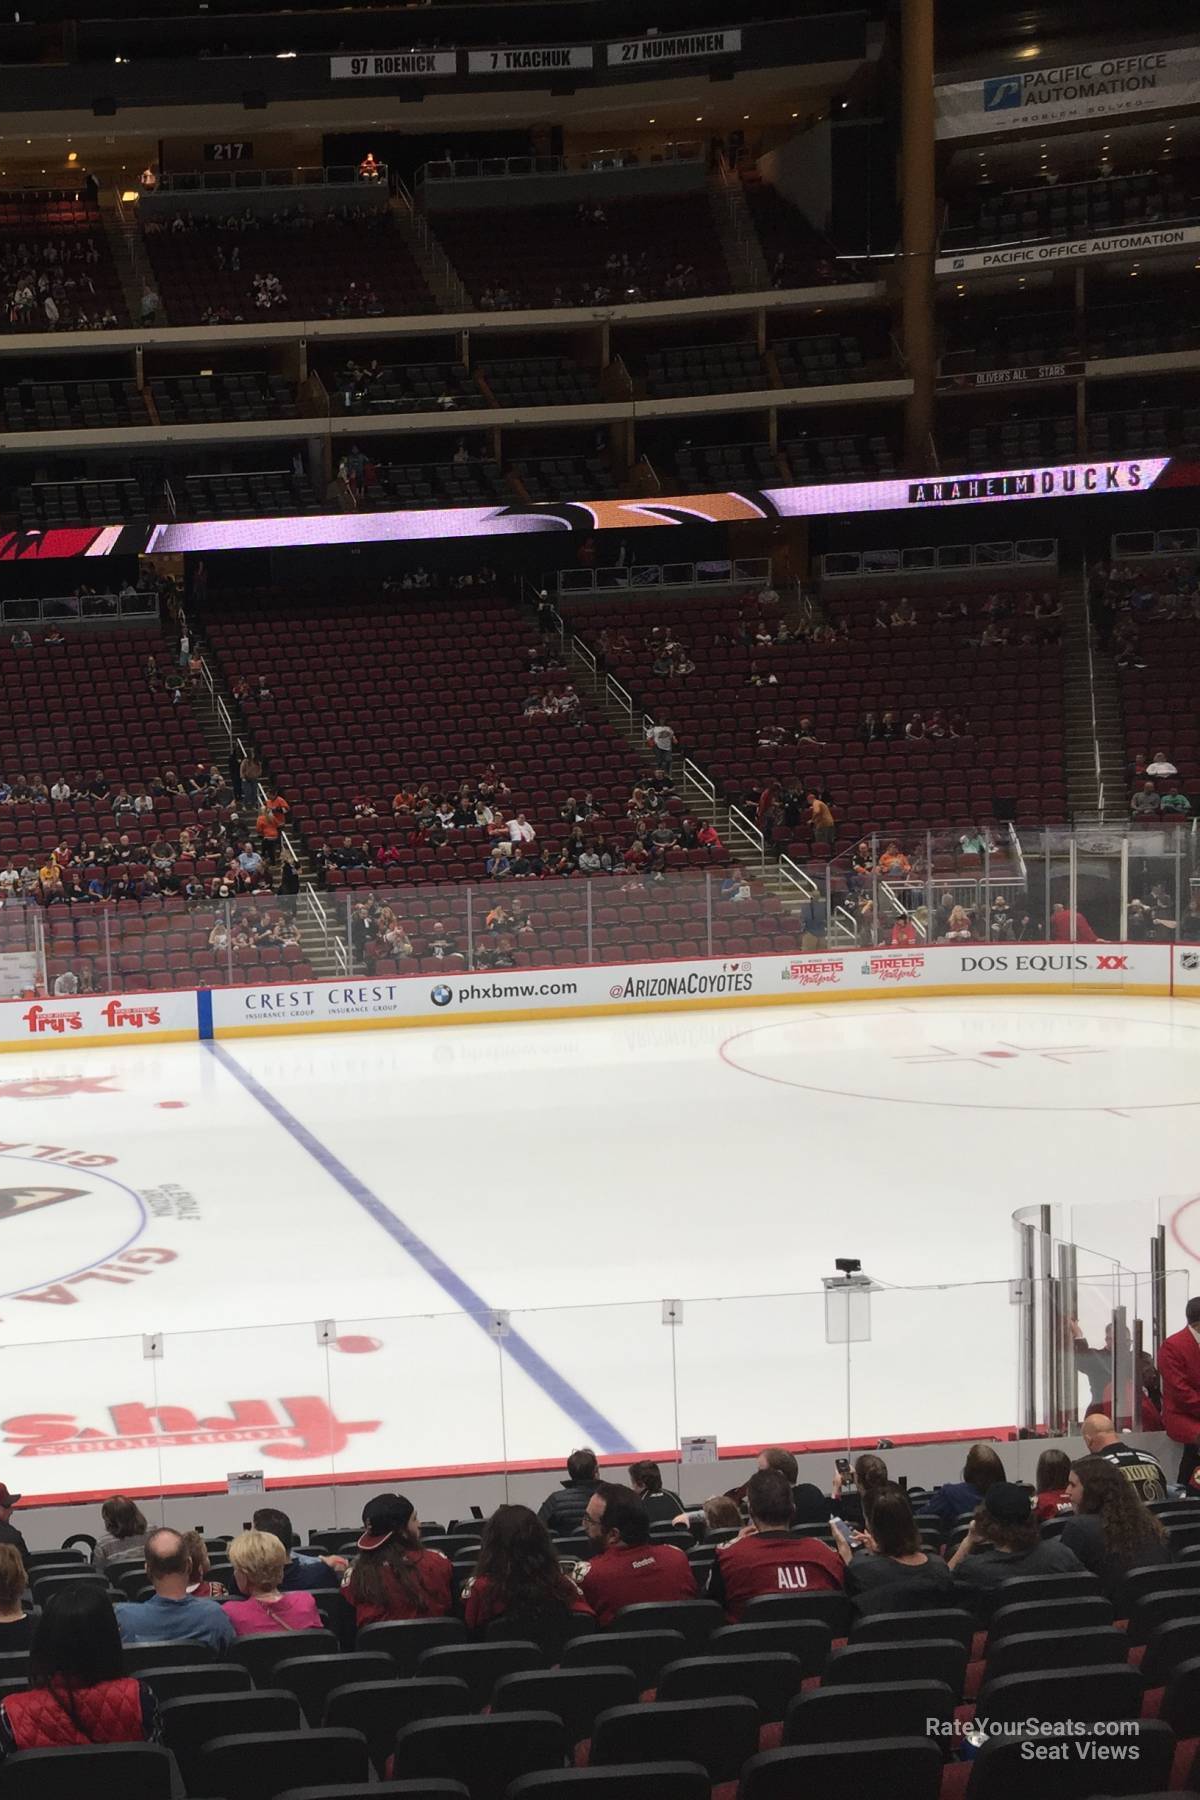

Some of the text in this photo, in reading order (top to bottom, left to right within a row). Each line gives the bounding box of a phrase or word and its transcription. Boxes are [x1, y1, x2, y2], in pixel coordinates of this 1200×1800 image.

[490, 49, 572, 68] 7 TKACHUK
[621, 34, 725, 61] 27 NUMMINEN
[351, 54, 436, 75] 97 ROENICK
[1023, 53, 1168, 88] PACIFIC OFFICE
[1024, 74, 1158, 107] AUTOMATION
[213, 143, 244, 161] 217
[983, 231, 1185, 266] PACIFIC OFFICE AUTOMATION
[1013, 369, 1027, 381] ALL
[1038, 365, 1066, 378] STARS
[916, 464, 1142, 501] ANAHEIM DUCKS
[791, 962, 844, 974] STREETS
[870, 957, 924, 970] STREETS
[961, 955, 1128, 972] DOS EQUIS XX
[245, 990, 315, 1010] CREST
[328, 985, 397, 1006] CREST
[458, 979, 578, 1003] phxbmw.com
[22, 1005, 83, 1033] fry's
[101, 1000, 161, 1028] fry's
[12, 1247, 178, 1305] GILA
[777, 1565, 808, 1589] ALU
